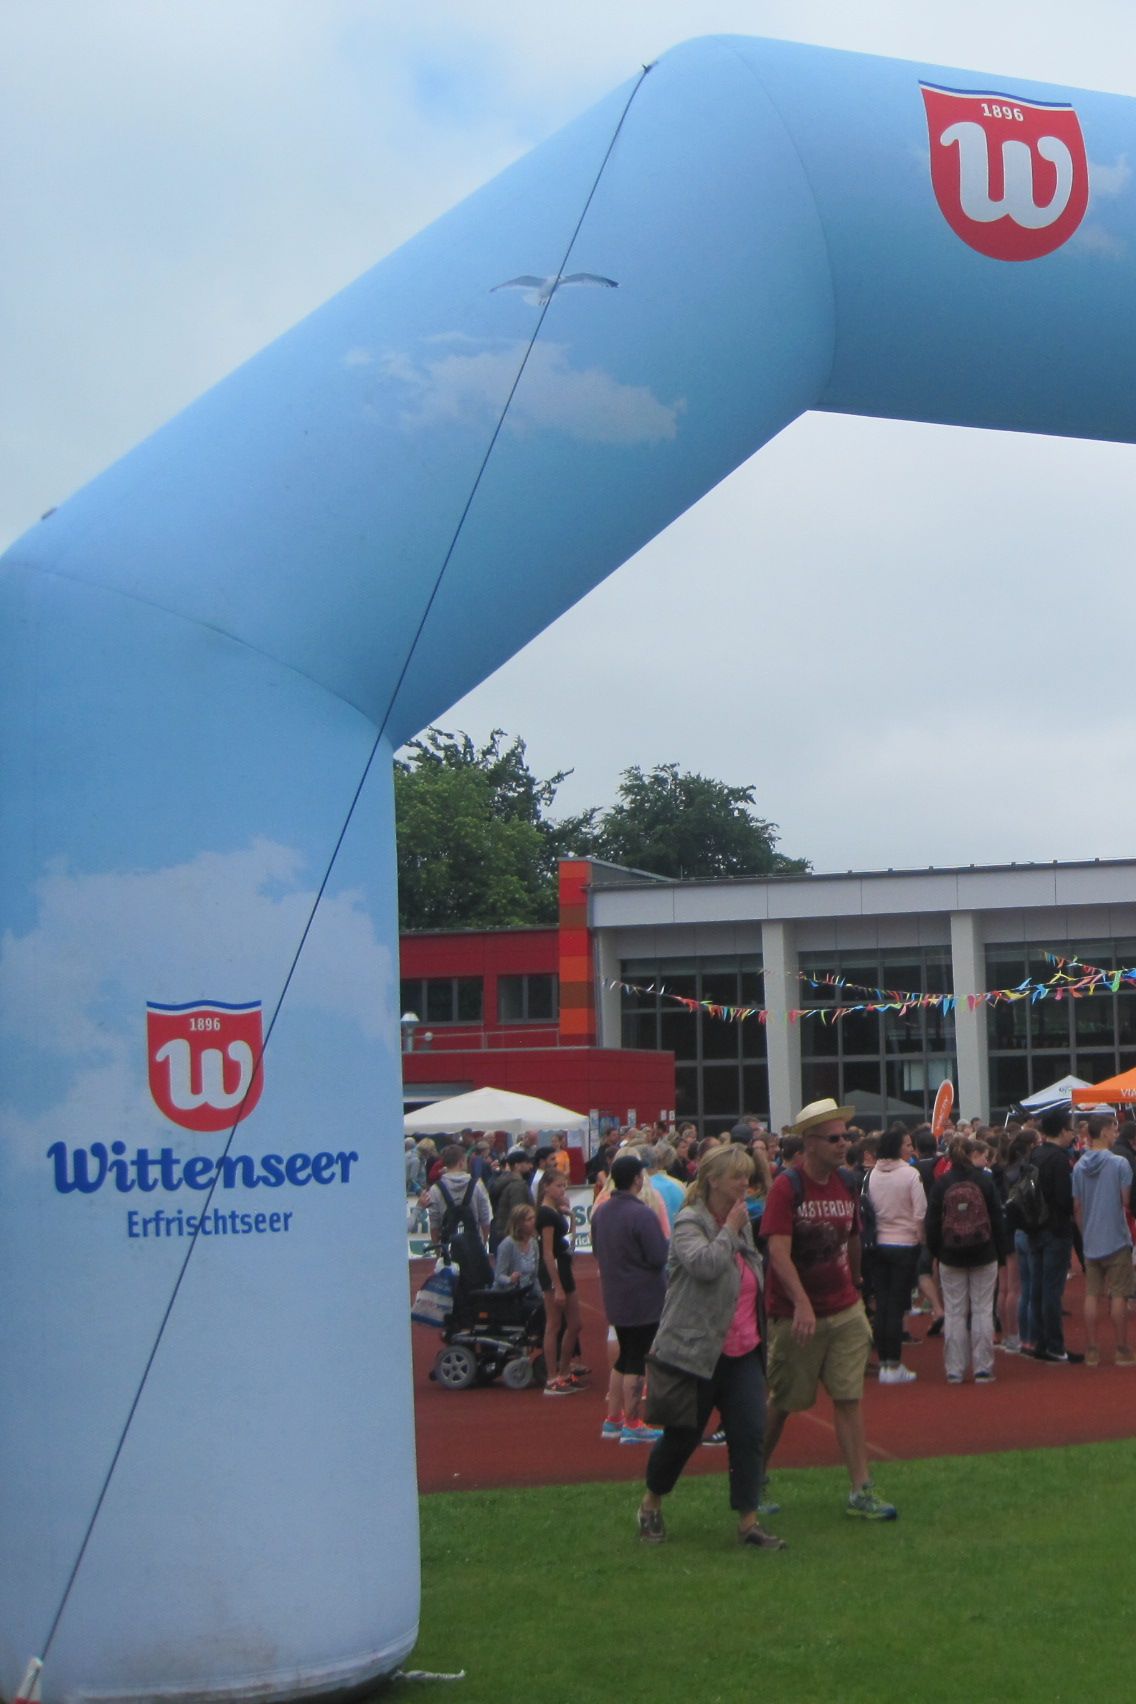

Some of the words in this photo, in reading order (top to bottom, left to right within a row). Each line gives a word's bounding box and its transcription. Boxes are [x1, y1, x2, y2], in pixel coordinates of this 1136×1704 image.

[981, 103, 1024, 122] 1896
[189, 1017, 221, 1032] 1896
[47, 1140, 358, 1194] Wittenseer
[797, 1200, 855, 1217] MSTERDA
[127, 1209, 292, 1238] Erfrischtseer
